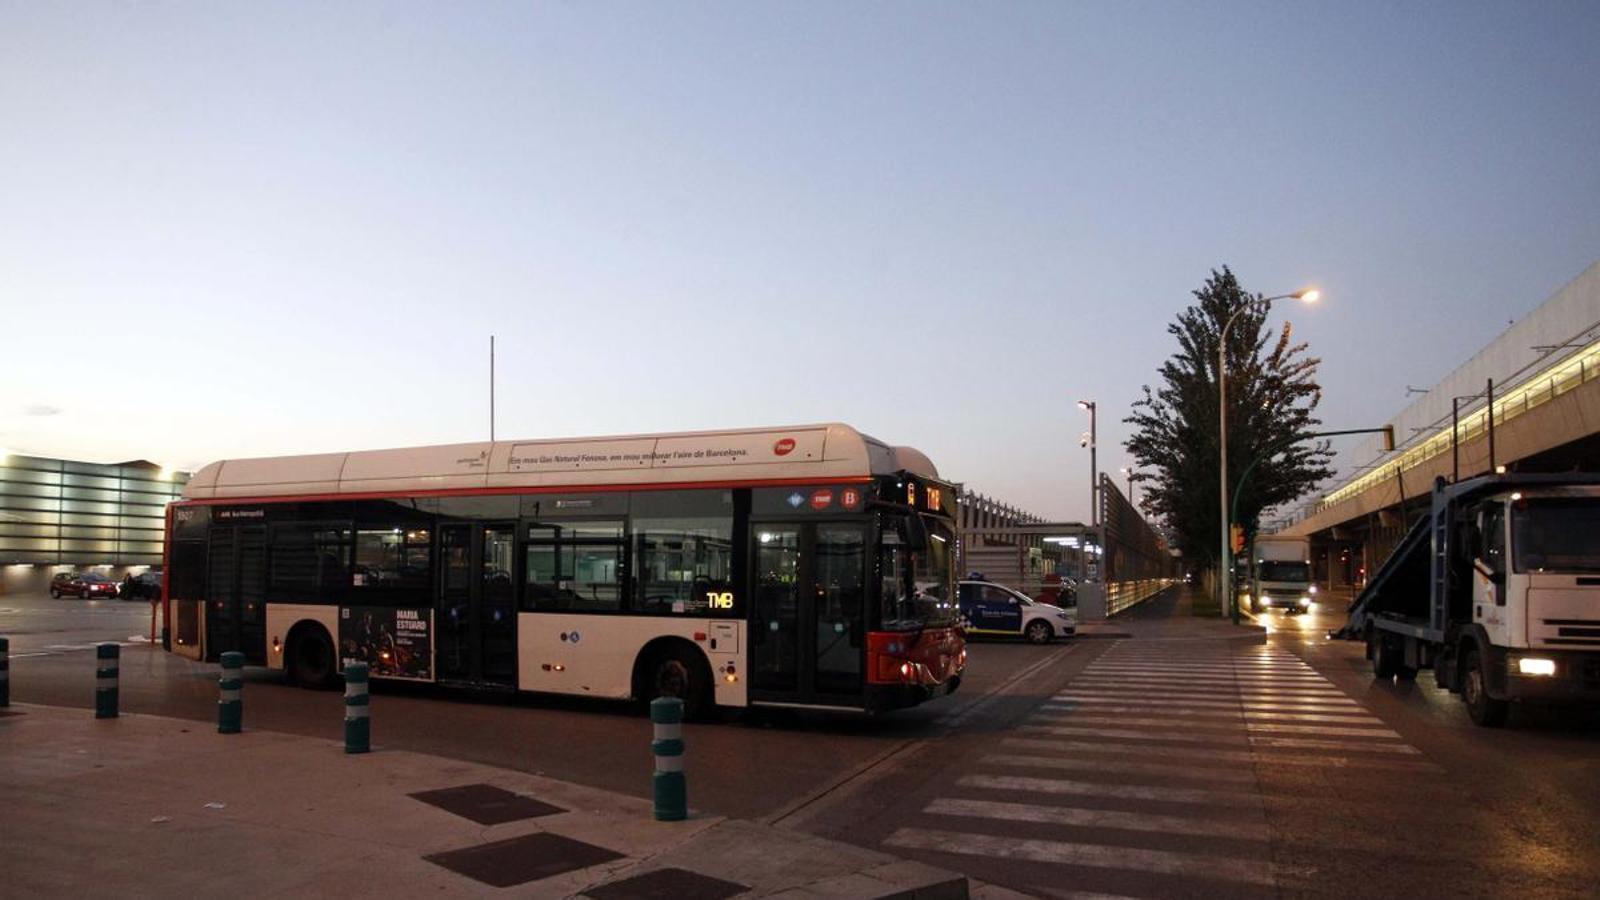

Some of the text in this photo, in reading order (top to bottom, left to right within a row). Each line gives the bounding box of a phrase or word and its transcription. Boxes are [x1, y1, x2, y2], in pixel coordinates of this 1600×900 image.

[555, 454, 580, 463] Natural
[693, 448, 704, 458] de
[706, 447, 748, 458] Barcelona.
[706, 592, 733, 609] TMB
[396, 610, 419, 620] MARIA
